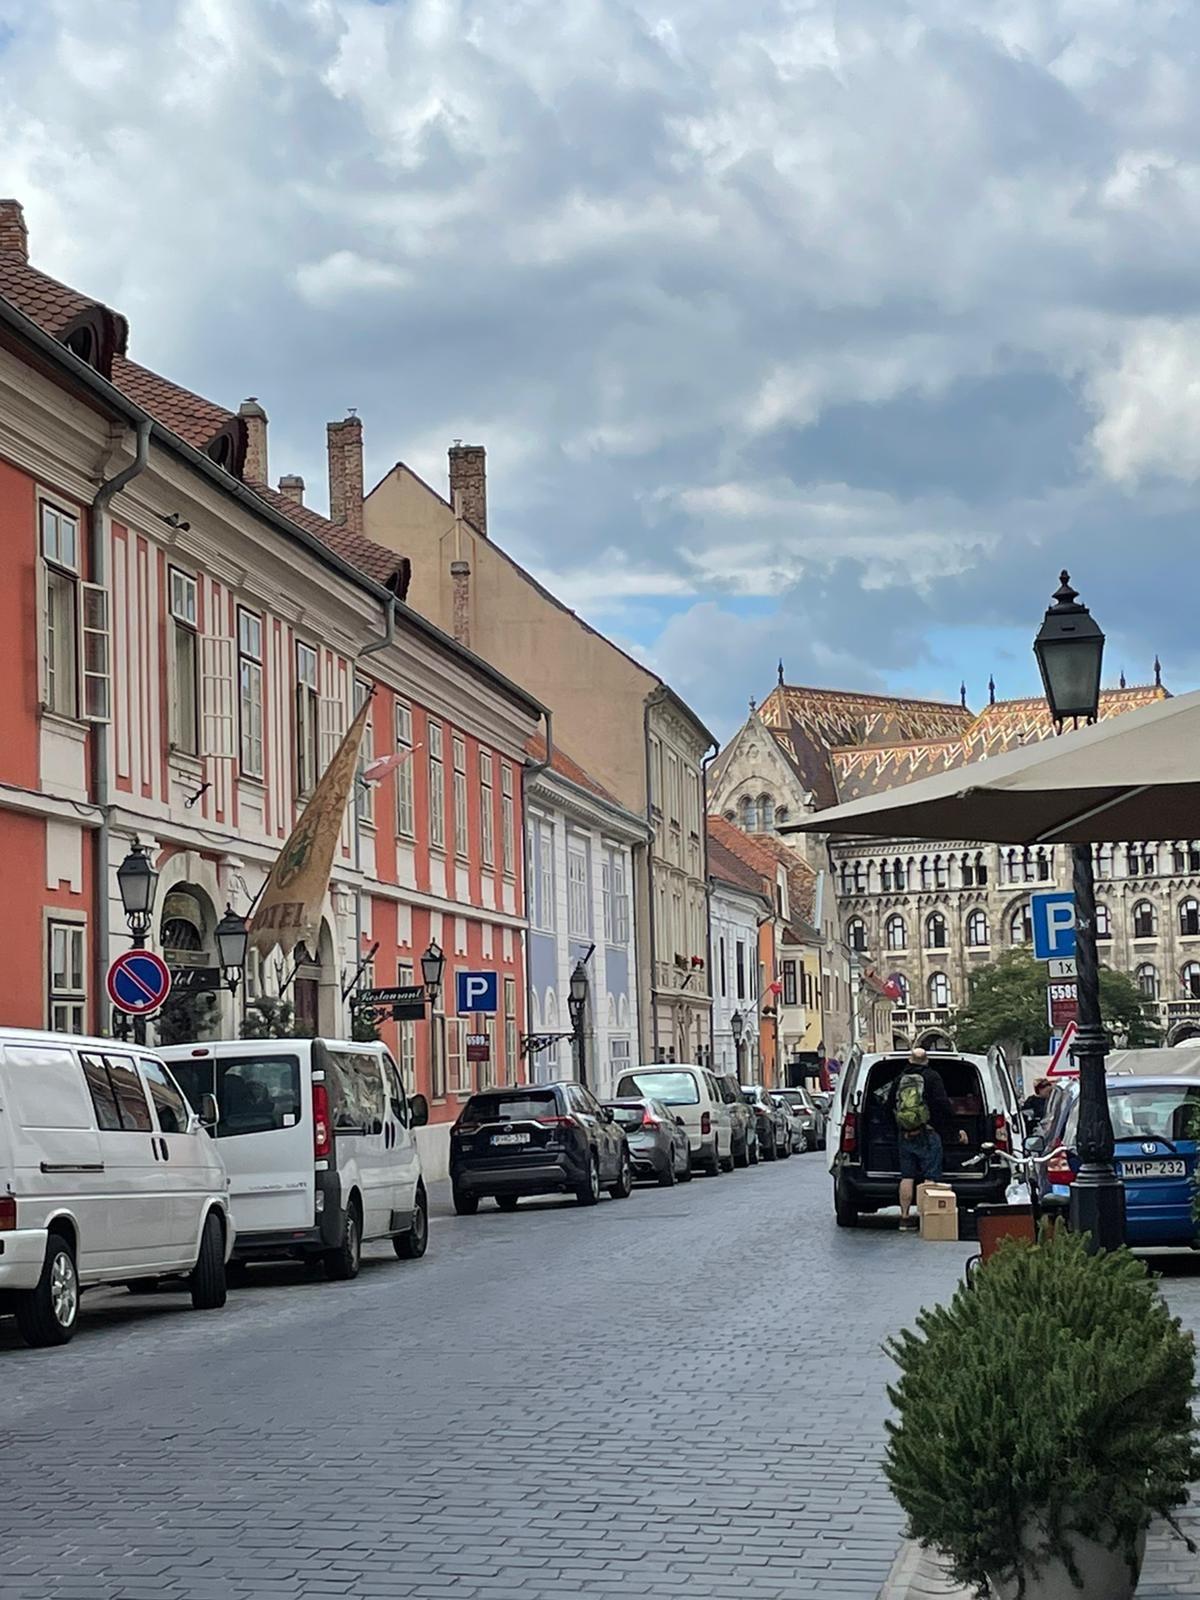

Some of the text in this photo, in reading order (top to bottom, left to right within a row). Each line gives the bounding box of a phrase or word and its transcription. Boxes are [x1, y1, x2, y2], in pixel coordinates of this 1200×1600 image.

[1046, 902, 1076, 950] P
[361, 988, 421, 1001] Restaurant
[466, 977, 488, 1008] P
[1051, 984, 1078, 999] 5589
[1125, 1161, 1183, 1175] MWP-232
